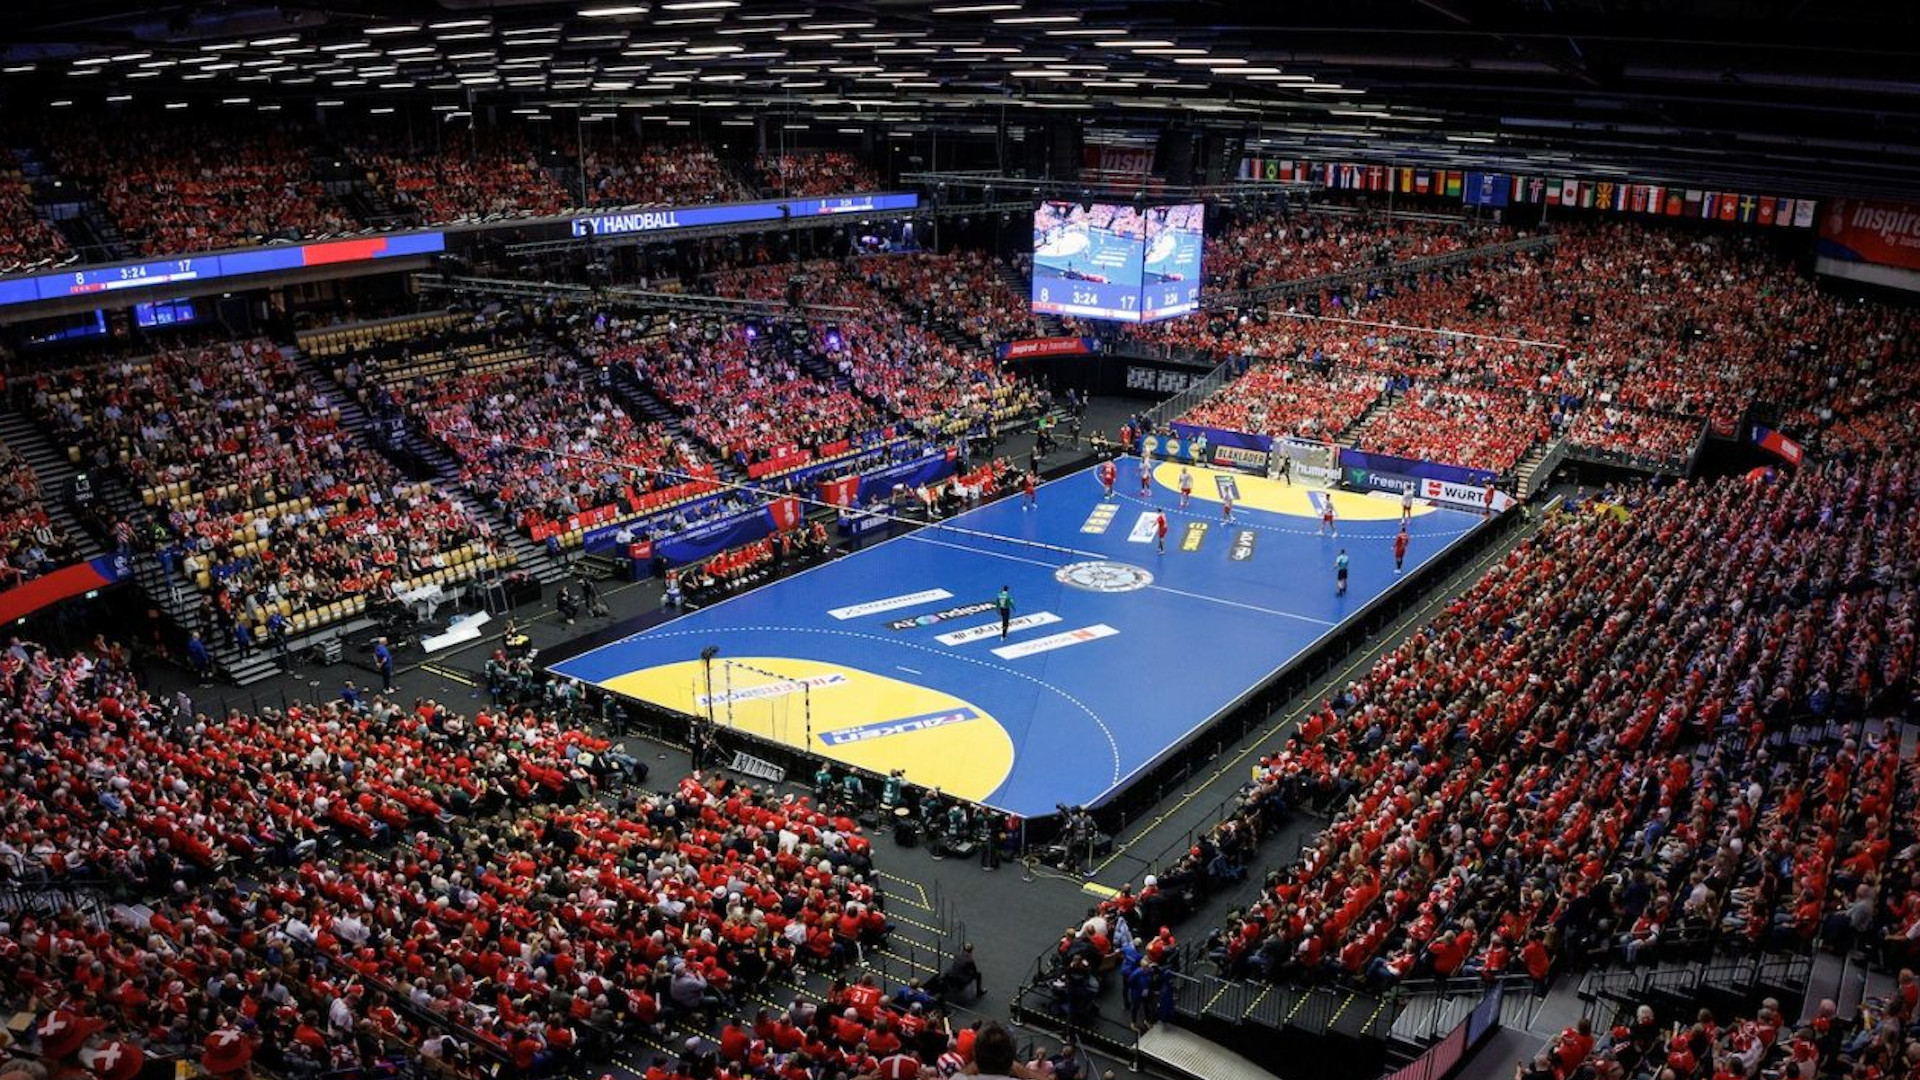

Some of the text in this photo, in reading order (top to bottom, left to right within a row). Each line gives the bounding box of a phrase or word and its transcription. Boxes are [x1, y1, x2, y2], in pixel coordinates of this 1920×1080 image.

[603, 211, 679, 232] HANDBALL
[120, 266, 147, 279] 3:24
[178, 260, 192, 272] 17
[75, 271, 85, 285] 8
[1040, 287, 1049, 302] 8
[1073, 291, 1099, 305] 3:24
[1120, 296, 1136, 309] 17
[1444, 486, 1487, 503] WÜRT
[852, 991, 869, 1004] 21
